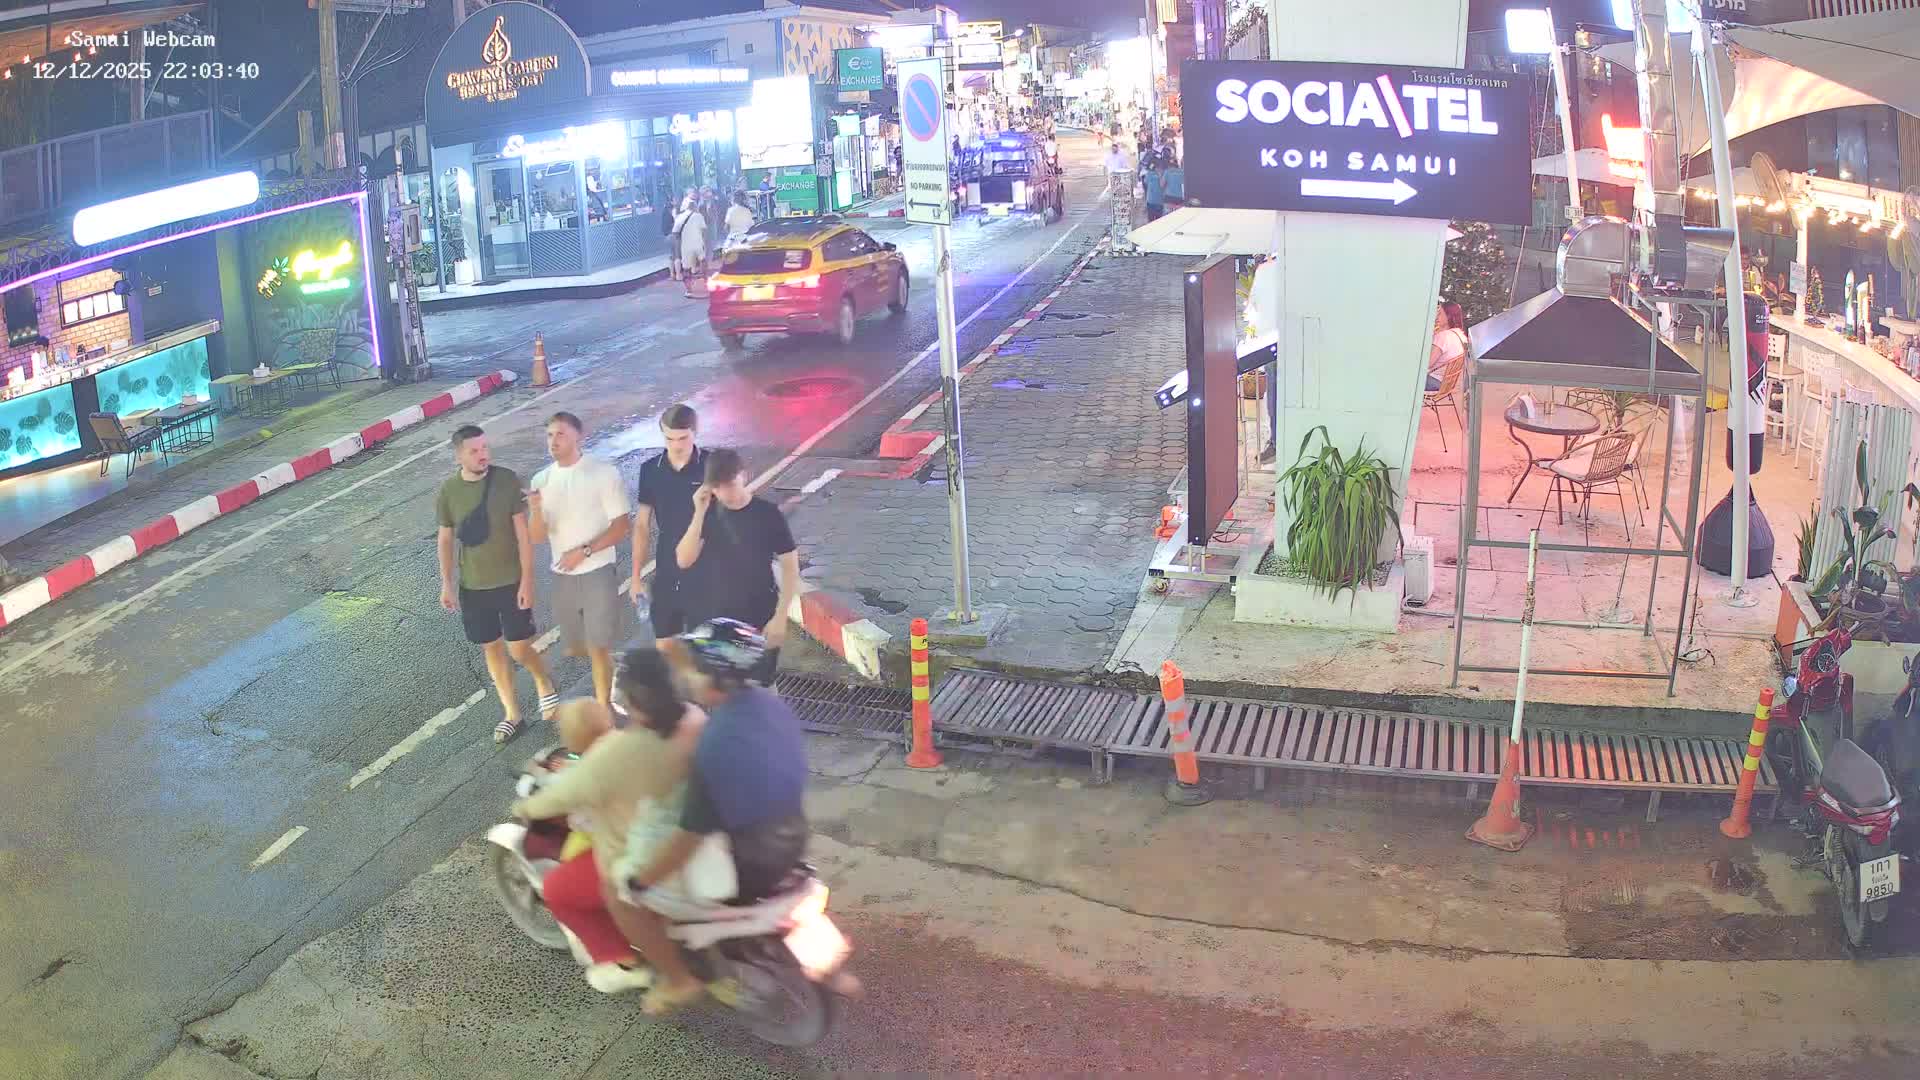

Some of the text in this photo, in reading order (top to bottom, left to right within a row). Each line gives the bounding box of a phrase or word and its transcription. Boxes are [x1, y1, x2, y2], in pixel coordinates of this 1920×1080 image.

[505, 56, 559, 75] GARDEN
[841, 75, 881, 86] EXCHANGE
[1260, 148, 1457, 176] KOH SAMUI
[778, 181, 816, 191] EXCHANGE
[910, 181, 942, 192] NO PARKING
[1866, 882, 1894, 898] 9850
